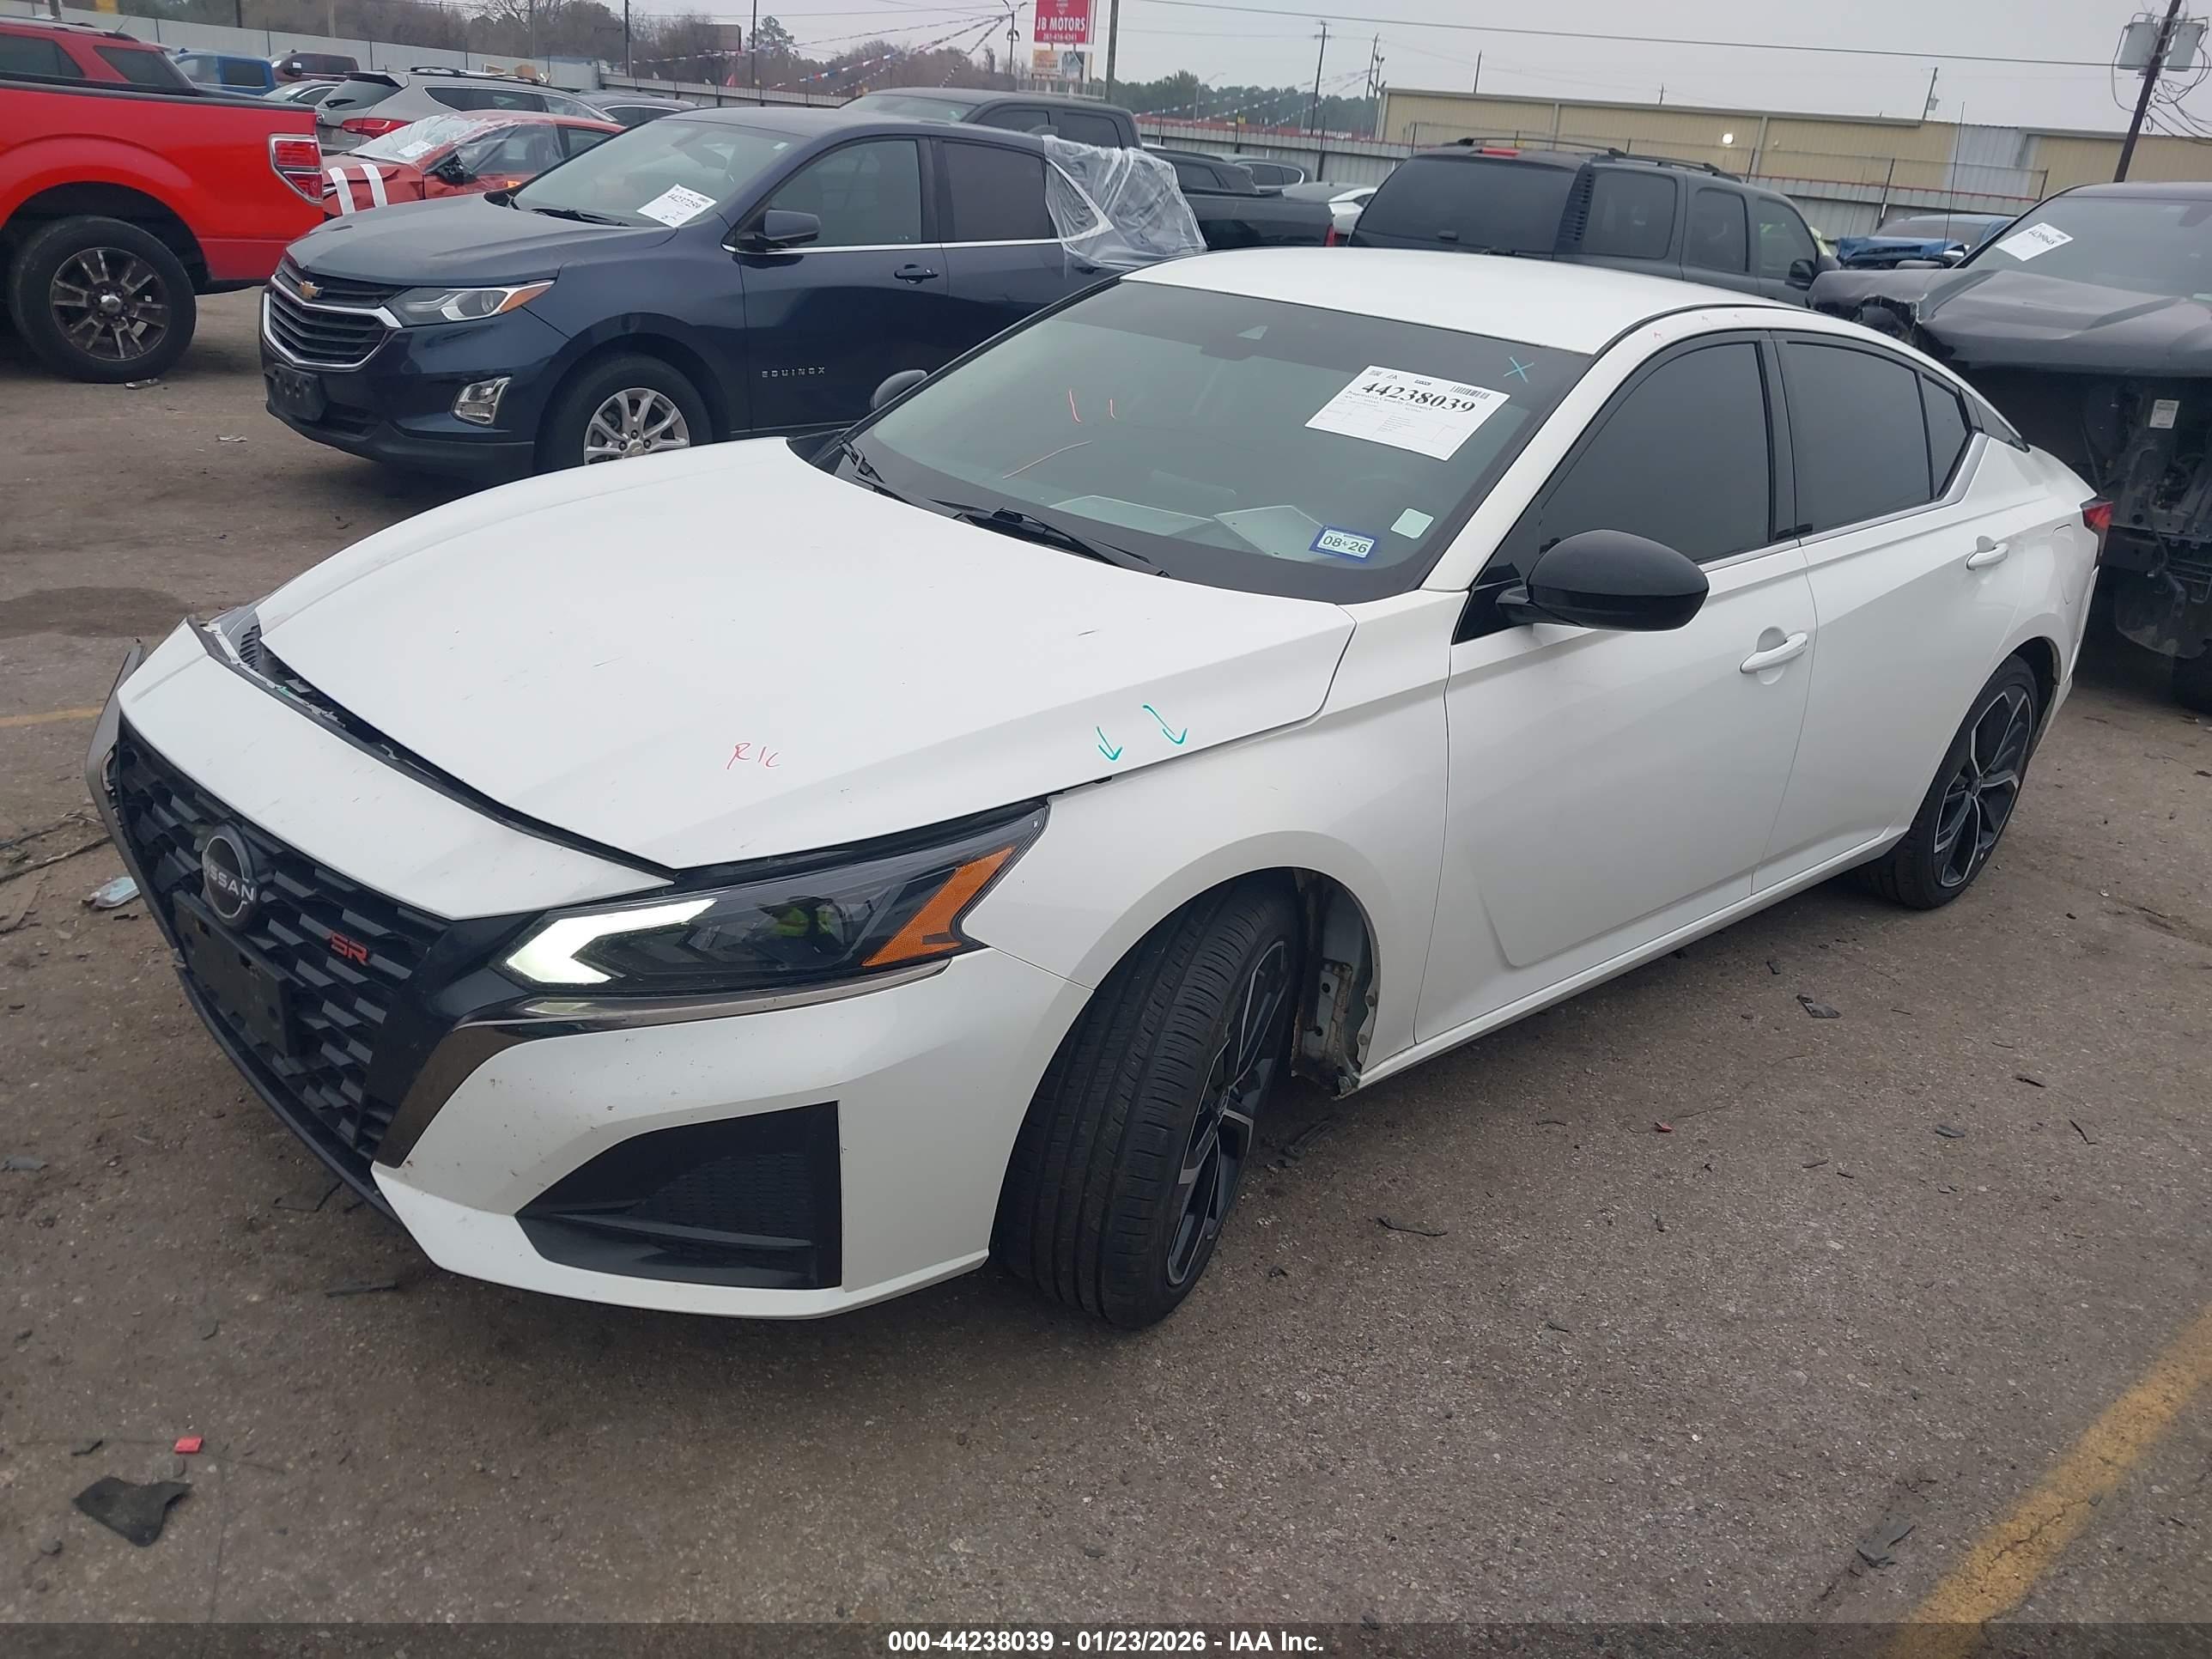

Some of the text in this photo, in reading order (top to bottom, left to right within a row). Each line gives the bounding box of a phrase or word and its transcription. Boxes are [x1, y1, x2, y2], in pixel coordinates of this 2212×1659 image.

[1036, 16, 1085, 32] JB MOTORS
[762, 367, 825, 378] EQUINOX
[1361, 382, 1476, 413] 44238039
[331, 932, 369, 967] SR
